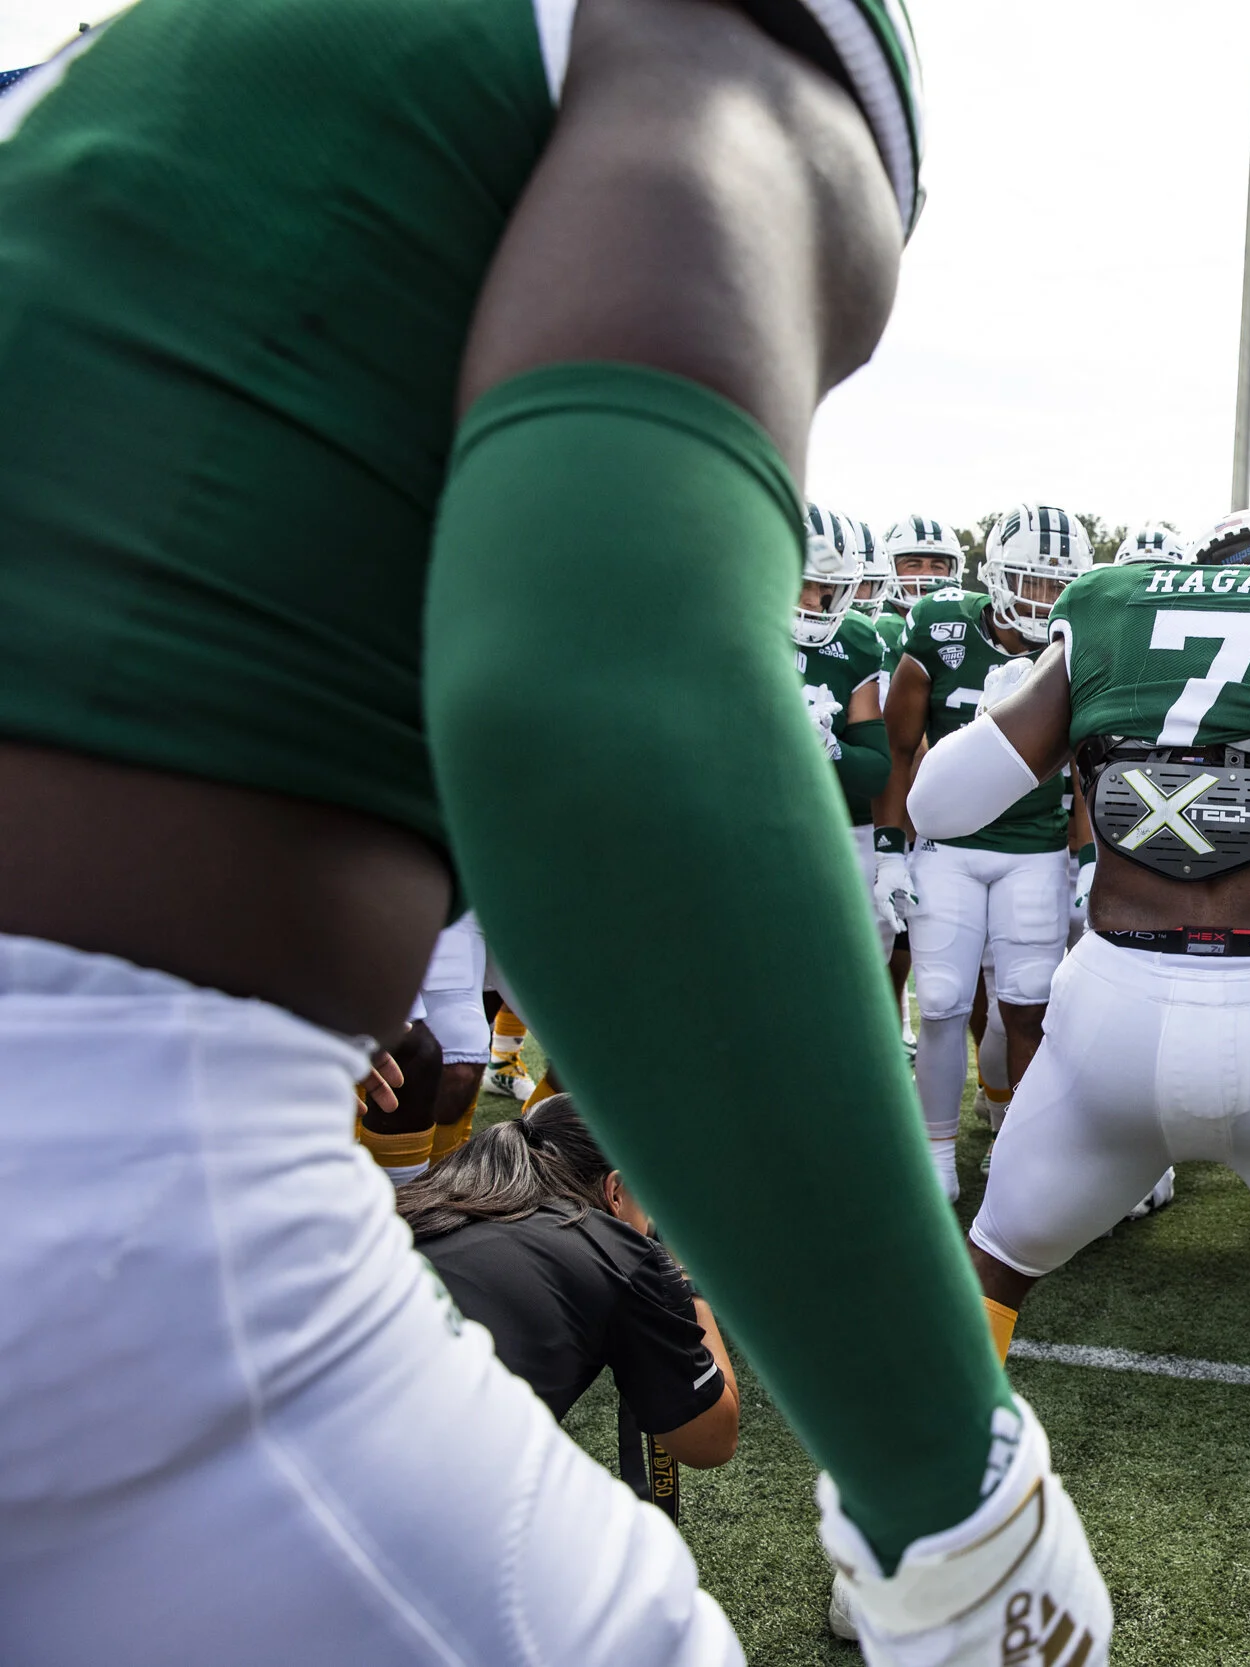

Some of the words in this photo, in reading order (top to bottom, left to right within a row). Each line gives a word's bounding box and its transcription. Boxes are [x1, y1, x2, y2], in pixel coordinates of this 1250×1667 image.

[930, 622, 967, 641] 150
[818, 648, 850, 661] adidas
[1188, 932, 1225, 941] HEX
